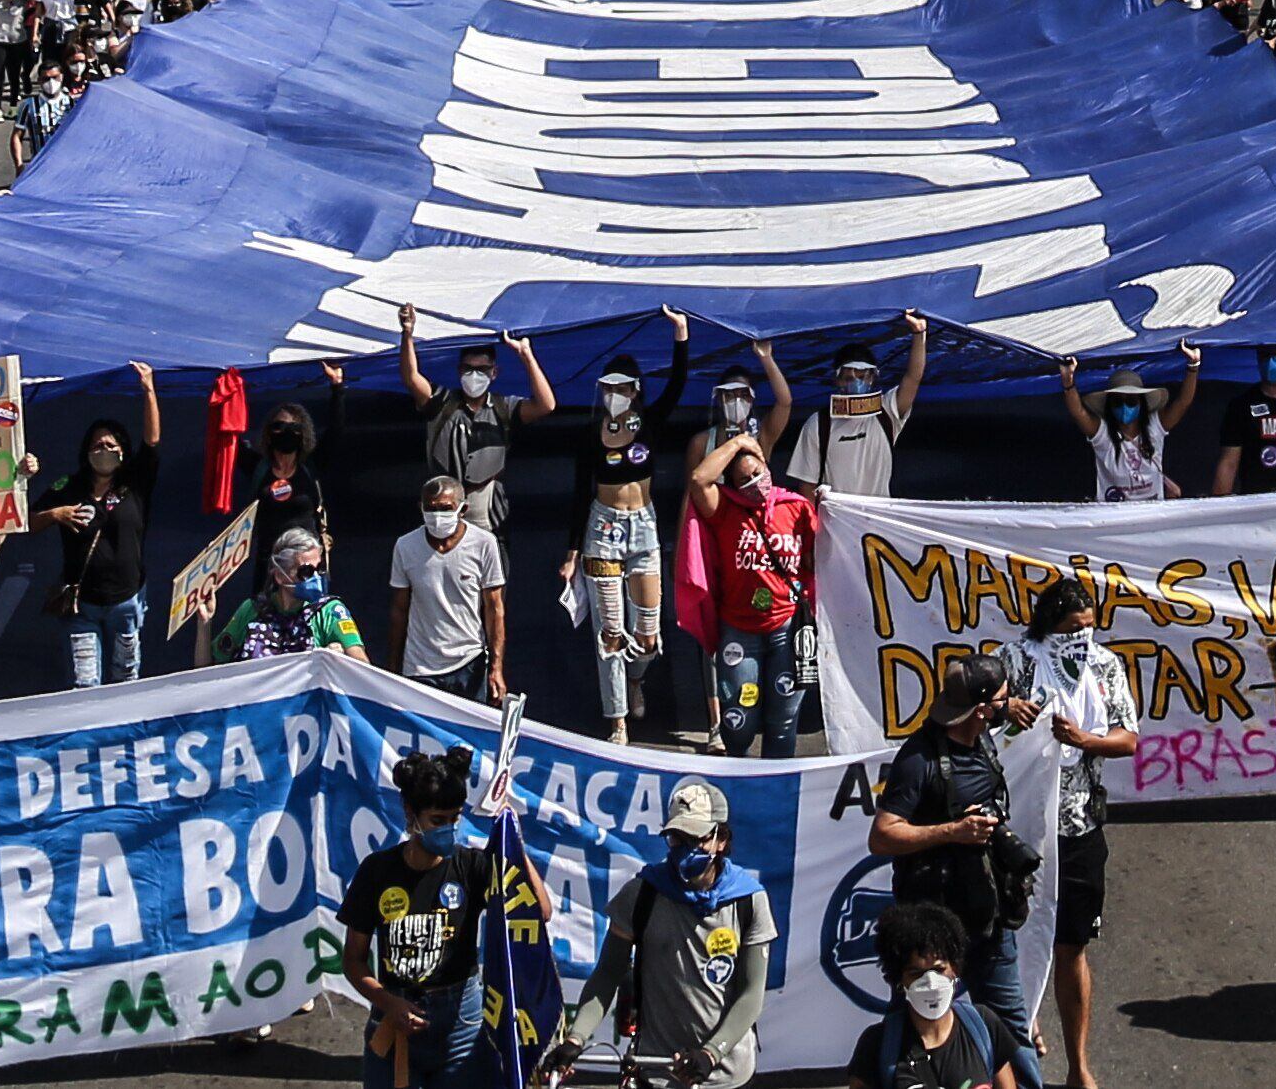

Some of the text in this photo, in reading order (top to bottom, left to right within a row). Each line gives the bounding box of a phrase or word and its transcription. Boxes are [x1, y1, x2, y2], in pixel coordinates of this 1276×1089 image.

[241, 24, 1248, 366] EDUCAÇ
[184, 518, 253, 596] FORA
[15, 722, 266, 824] DEFESA
[282, 711, 357, 779] DA
[388, 914, 444, 950] REVOLTA
[198, 957, 287, 1014] AO
